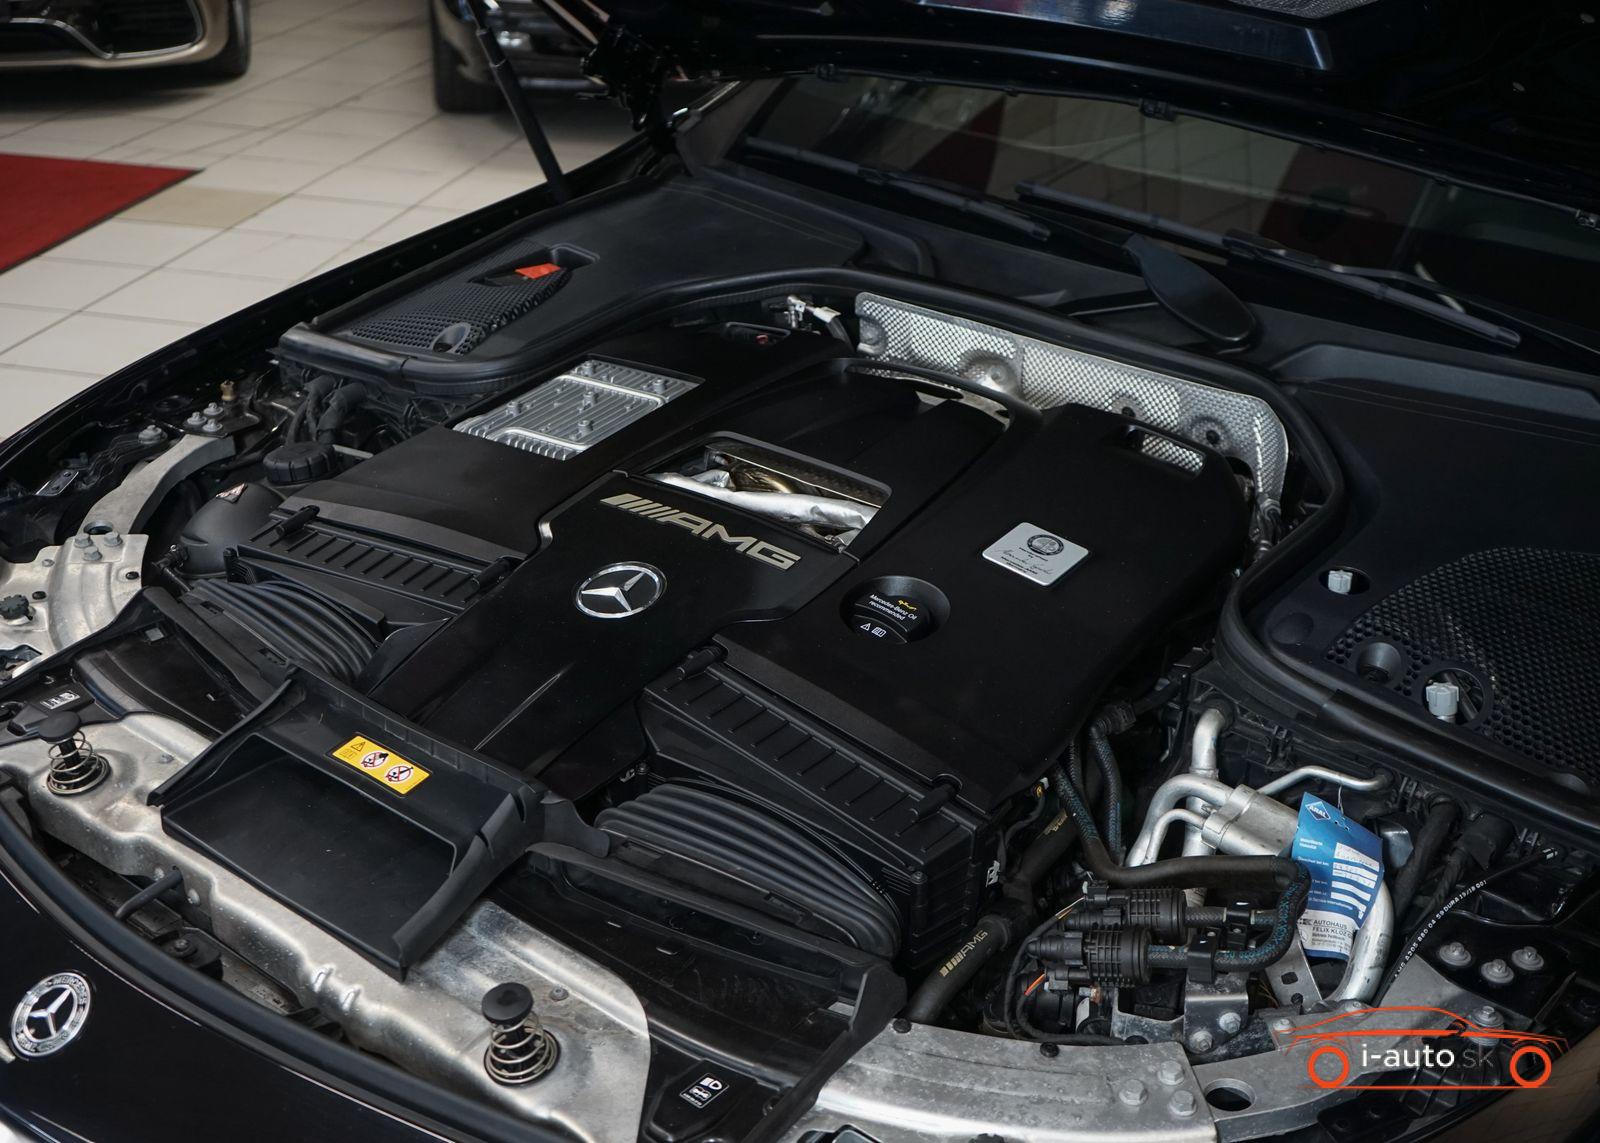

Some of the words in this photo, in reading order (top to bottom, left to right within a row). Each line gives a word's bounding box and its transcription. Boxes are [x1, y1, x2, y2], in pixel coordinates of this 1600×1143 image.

[656, 511, 801, 570] AMG
[868, 600, 906, 621] recommended
[869, 594, 908, 616] Mercedes-Benz
[1308, 804, 1327, 818] ARAL
[1443, 896, 1460, 913] DURA
[1313, 920, 1348, 930] AUTOHAUS
